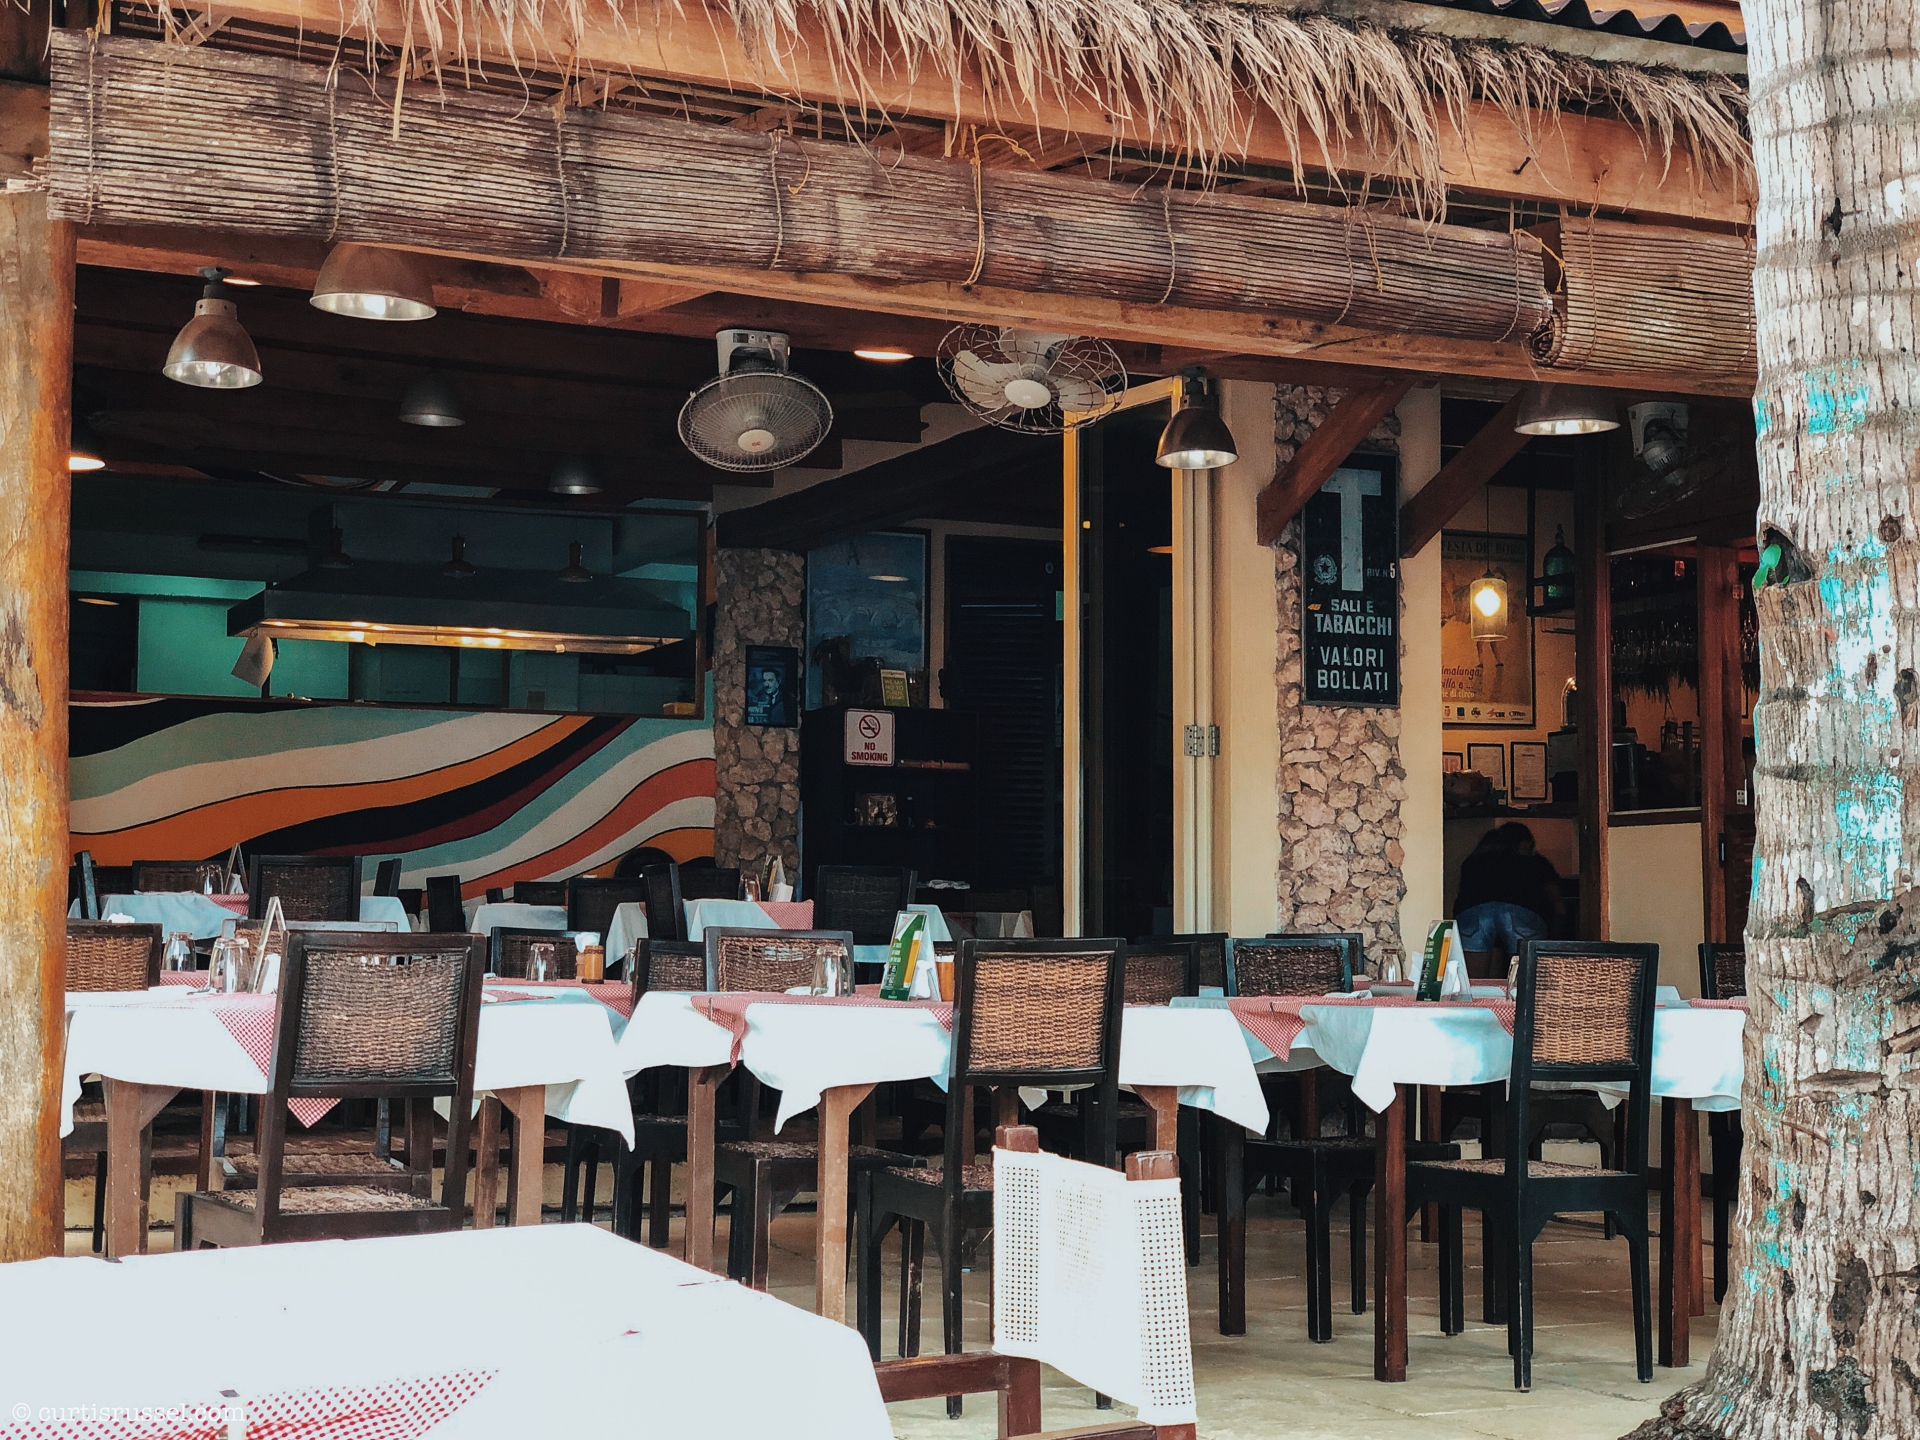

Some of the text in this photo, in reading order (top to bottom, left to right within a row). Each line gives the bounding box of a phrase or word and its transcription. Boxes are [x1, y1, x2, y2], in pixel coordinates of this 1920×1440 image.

[1321, 468, 1382, 591] T
[1389, 562, 1396, 579] 5
[1330, 599, 1374, 614] SALI E
[1314, 613, 1392, 636] TABACCHI
[1319, 646, 1384, 668] VALORI
[1317, 669, 1388, 691] BOLLATI
[851, 751, 888, 761] SMOKING
[864, 742, 876, 751] NO
